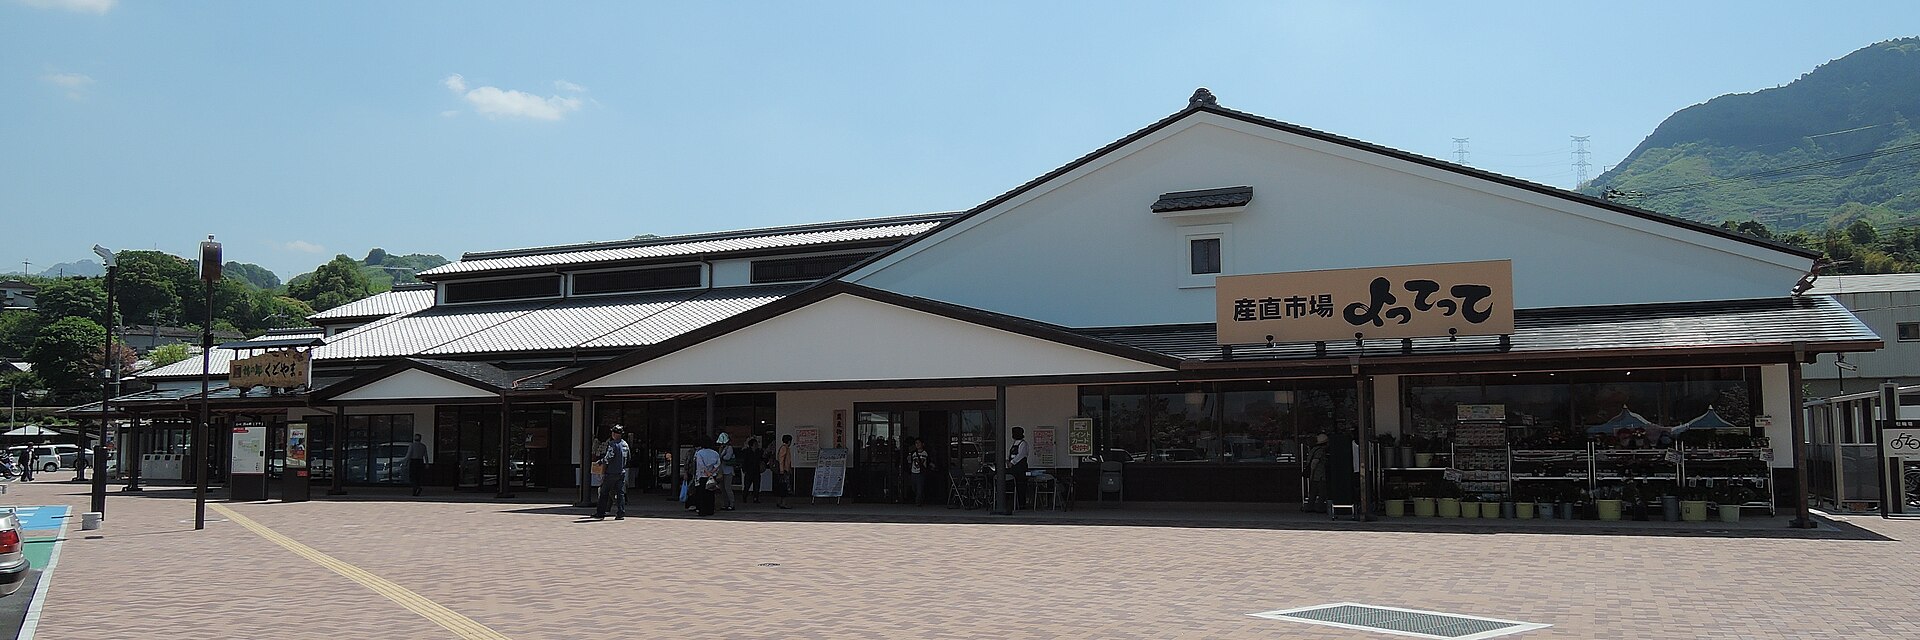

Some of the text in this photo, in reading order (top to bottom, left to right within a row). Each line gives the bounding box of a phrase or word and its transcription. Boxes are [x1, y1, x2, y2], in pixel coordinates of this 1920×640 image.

[1233, 277, 1493, 327] 産直市場 よってって
